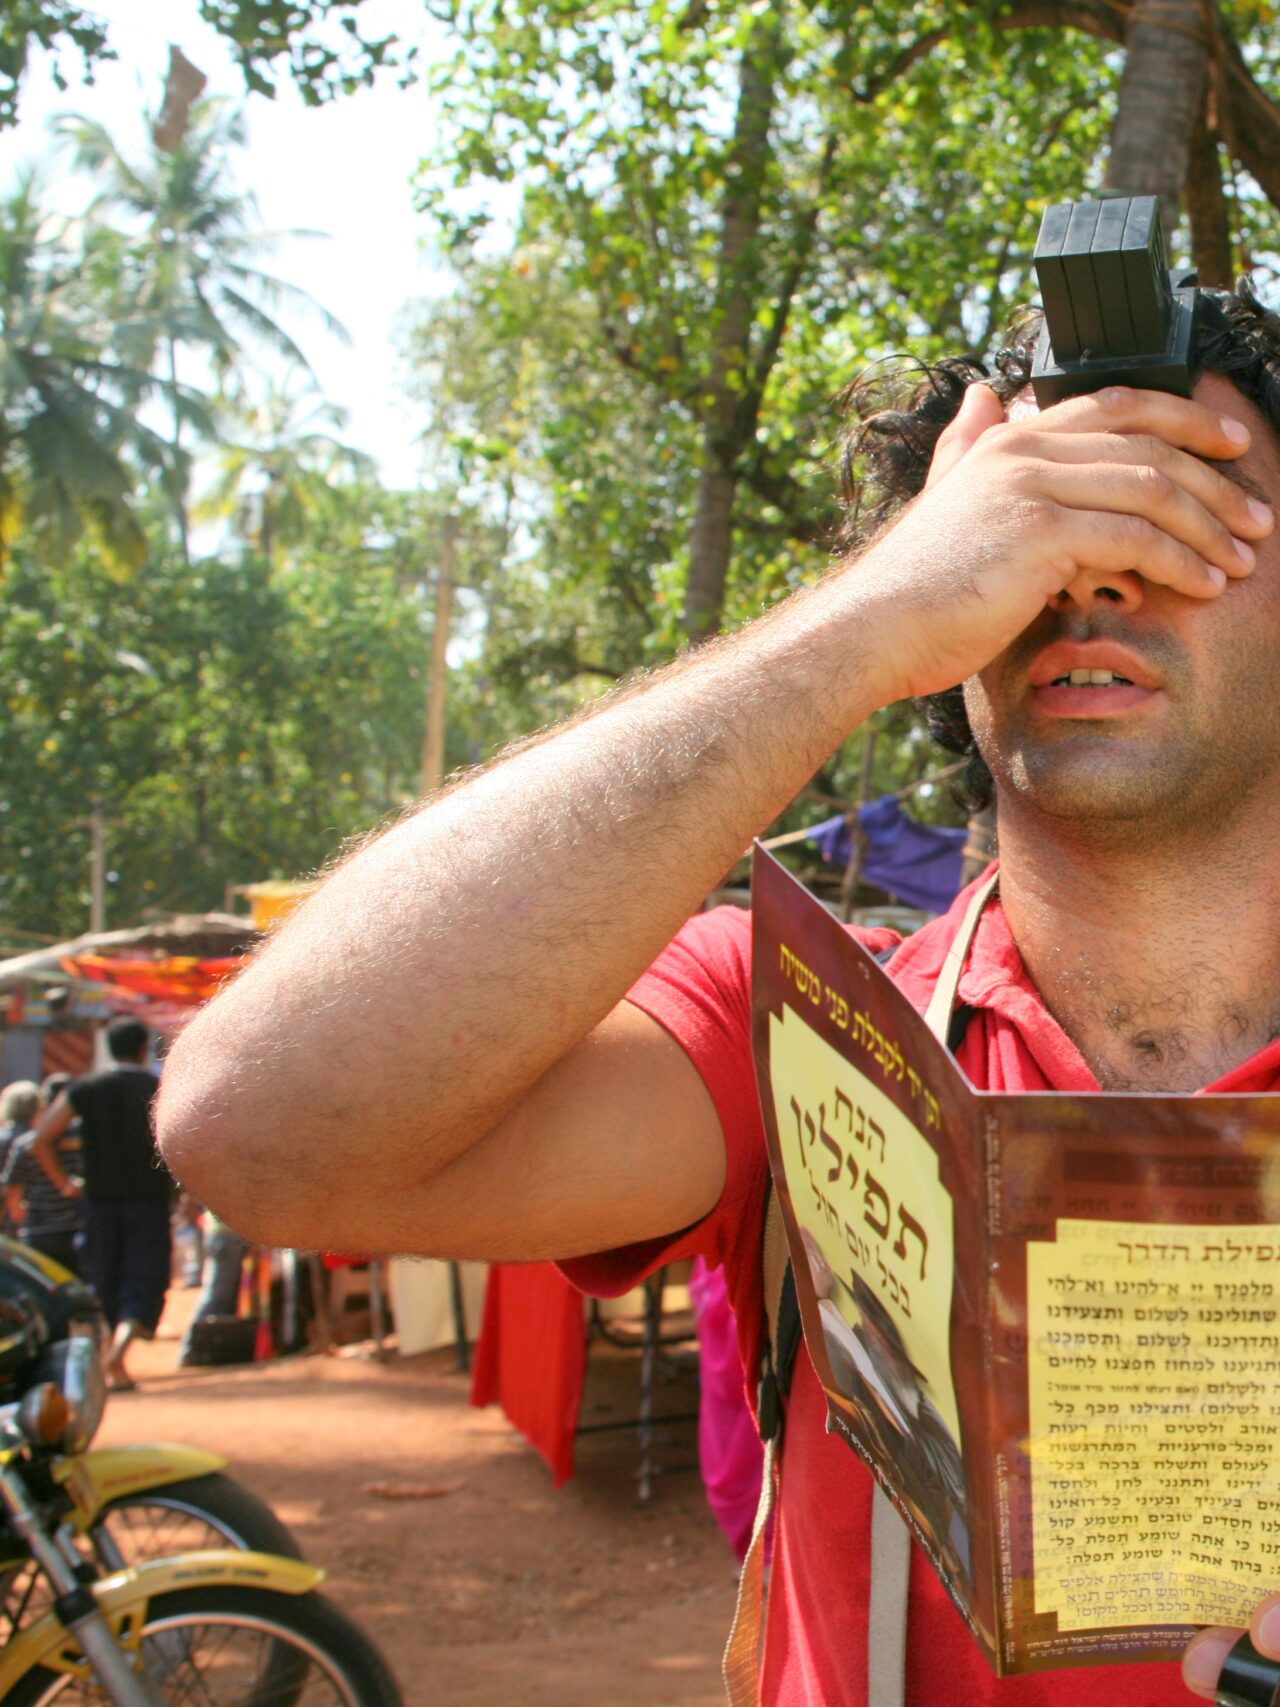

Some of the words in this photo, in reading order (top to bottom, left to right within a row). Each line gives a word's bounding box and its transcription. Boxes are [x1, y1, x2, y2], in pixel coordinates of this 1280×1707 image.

[834, 1084, 887, 1164] הנח
[791, 1094, 929, 1281] תפילין
[846, 1219, 871, 1268] יום
[1118, 1243, 1189, 1265] הדרך
[877, 1246, 912, 1318] בכל
